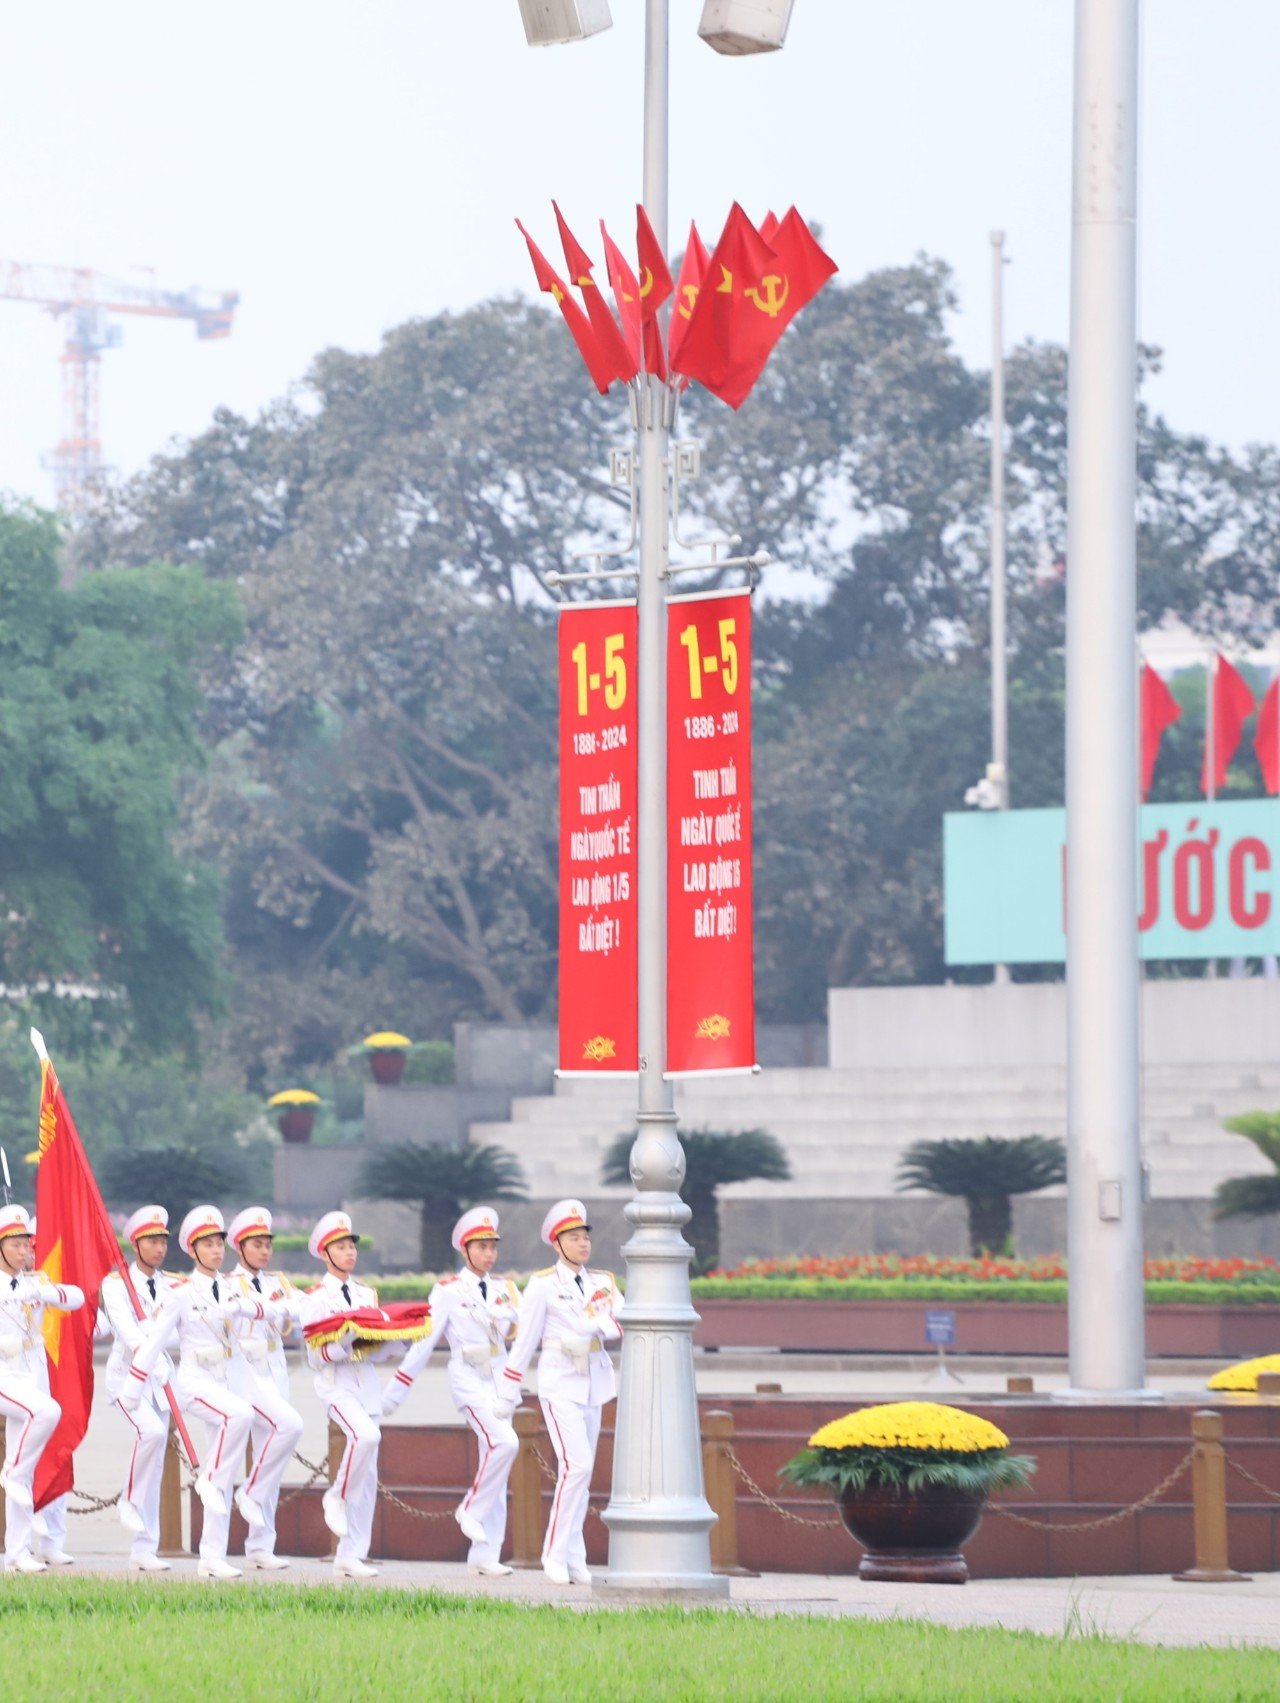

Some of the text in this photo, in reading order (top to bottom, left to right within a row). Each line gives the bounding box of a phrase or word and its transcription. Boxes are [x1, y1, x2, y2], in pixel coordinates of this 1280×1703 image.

[572, 633, 627, 716] 1-5
[680, 618, 738, 699] 1-5
[601, 724, 627, 751] 2024
[684, 715, 715, 739] 1886
[617, 815, 631, 855] TẾ
[681, 810, 713, 846] NGÀY
[572, 877, 589, 906] LAO
[613, 872, 630, 901] 1/5
[683, 862, 707, 892] LAO
[1062, 817, 1272, 935] ƯỚC
